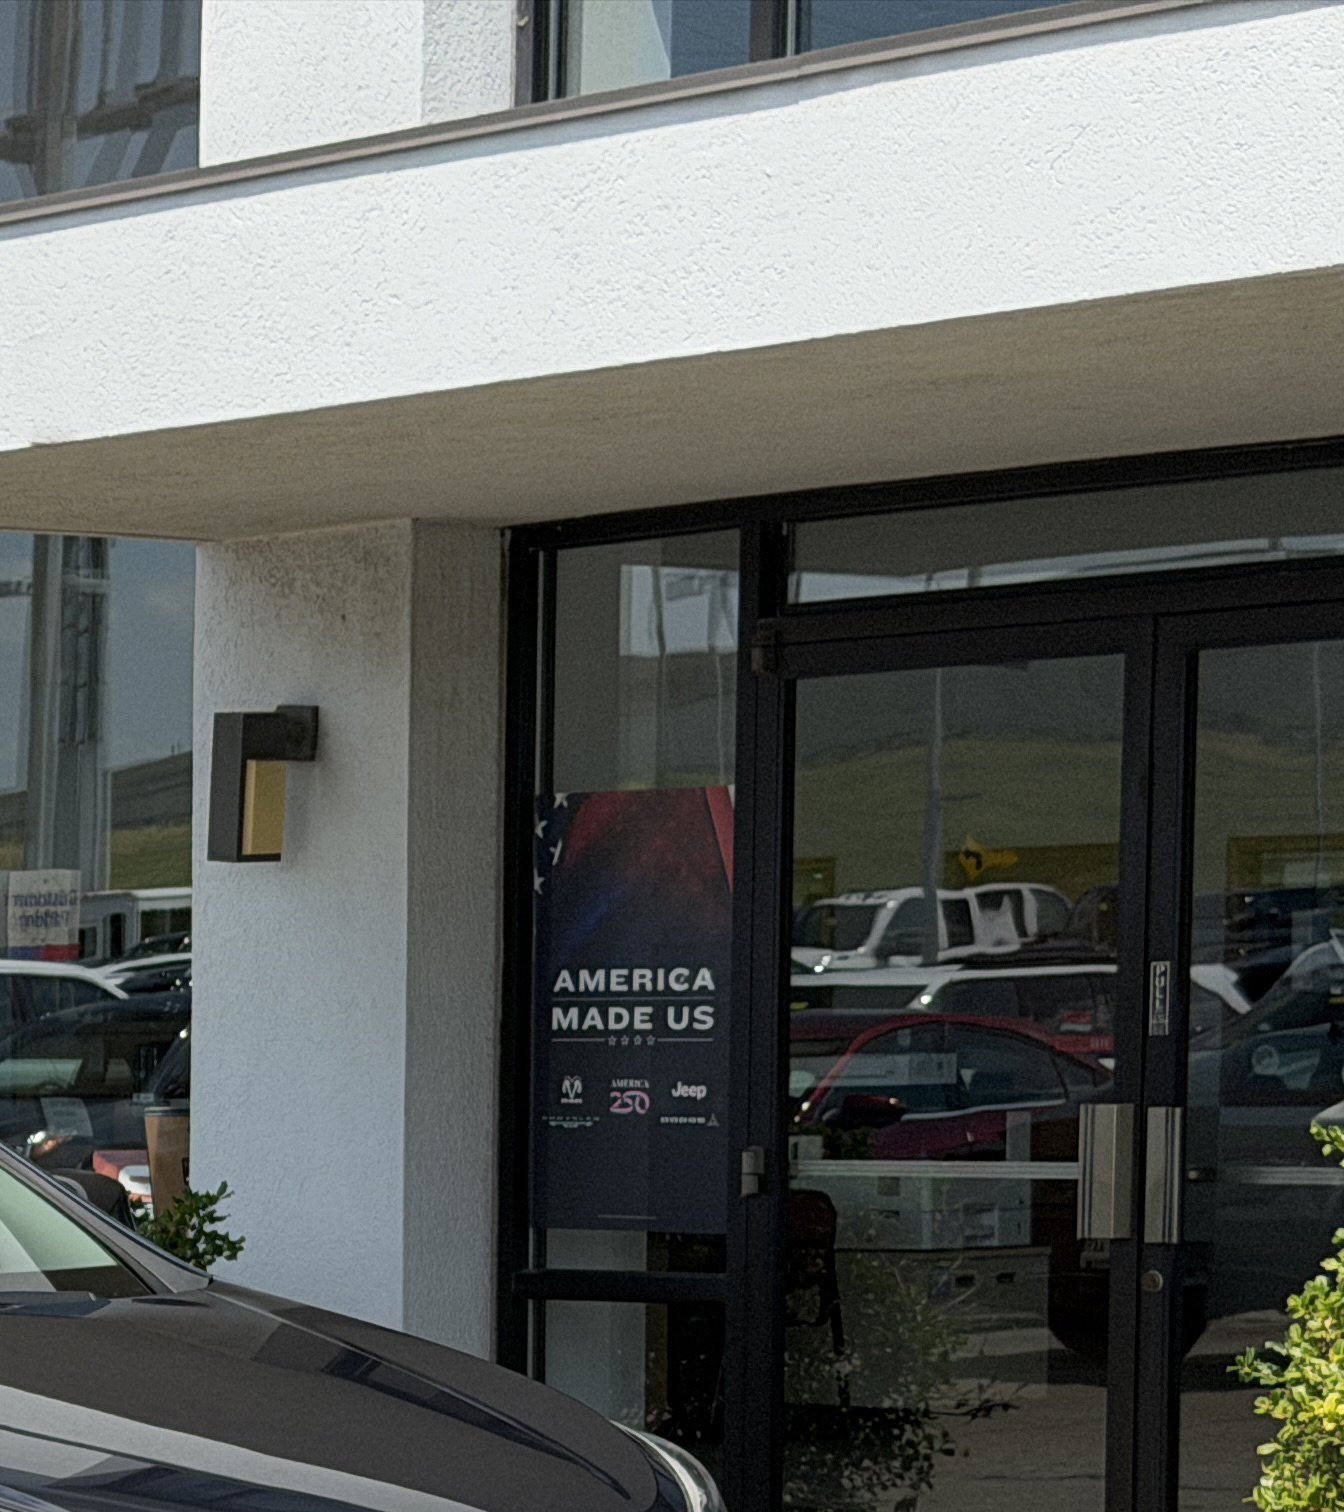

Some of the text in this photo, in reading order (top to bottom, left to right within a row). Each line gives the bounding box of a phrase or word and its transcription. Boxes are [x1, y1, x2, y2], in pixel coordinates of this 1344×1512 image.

[553, 967, 715, 992] AMERICA
[551, 1005, 715, 1030] MADE US
[608, 1090, 651, 1116] 250
[671, 1080, 708, 1102] Jeep
